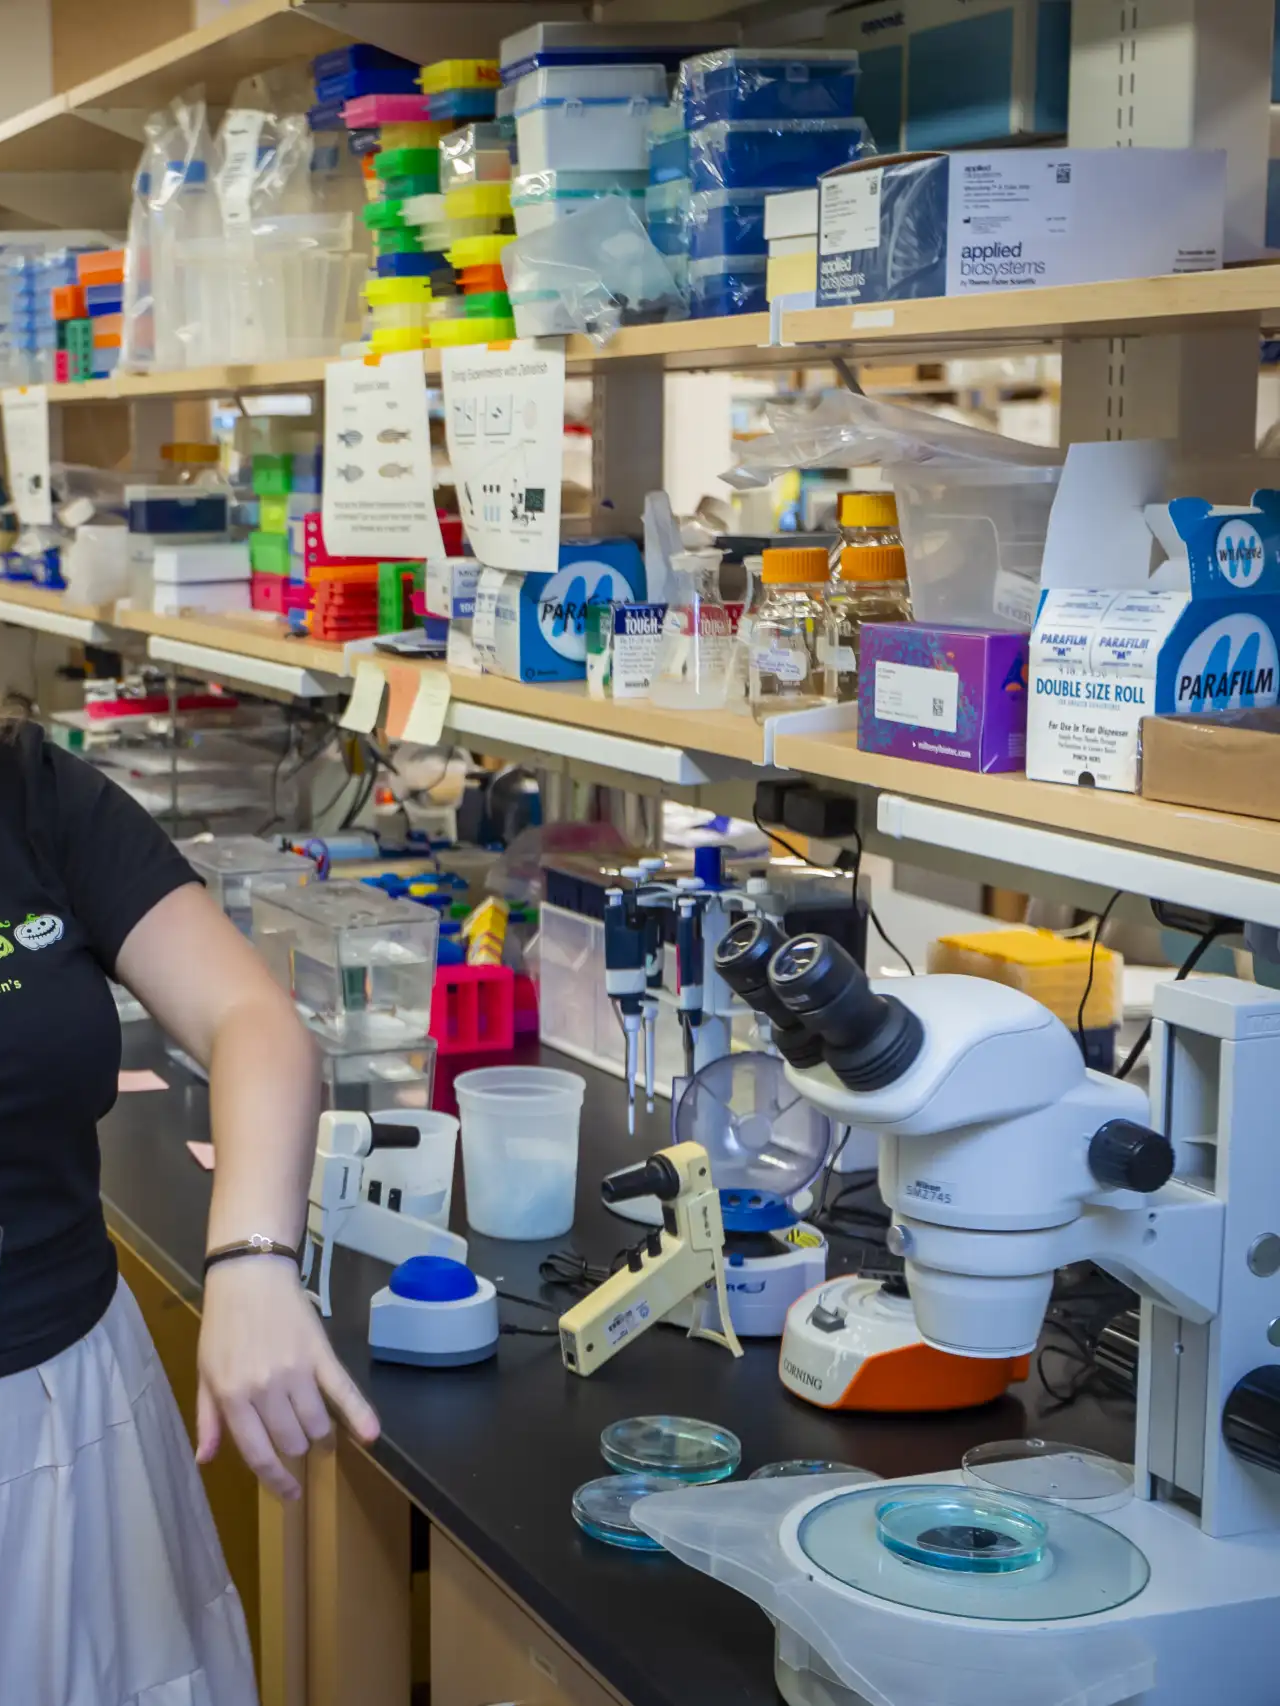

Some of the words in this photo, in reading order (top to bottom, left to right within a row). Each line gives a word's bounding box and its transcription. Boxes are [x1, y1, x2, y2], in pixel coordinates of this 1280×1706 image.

[961, 240, 1022, 261] applied
[820, 255, 852, 275] applied
[960, 260, 1045, 280] biosystems
[820, 272, 865, 290] biosystems
[1040, 632, 1088, 646] PARAFILM
[1099, 636, 1150, 649] PARAFILM
[1036, 677, 1082, 699] DOUBLE
[1085, 682, 1111, 701] SIZE
[1115, 685, 1145, 704] ROLL
[1178, 667, 1274, 702] PARAFILM
[1098, 726, 1128, 738] Dispenser
[783, 1358, 822, 1391] CORNING
